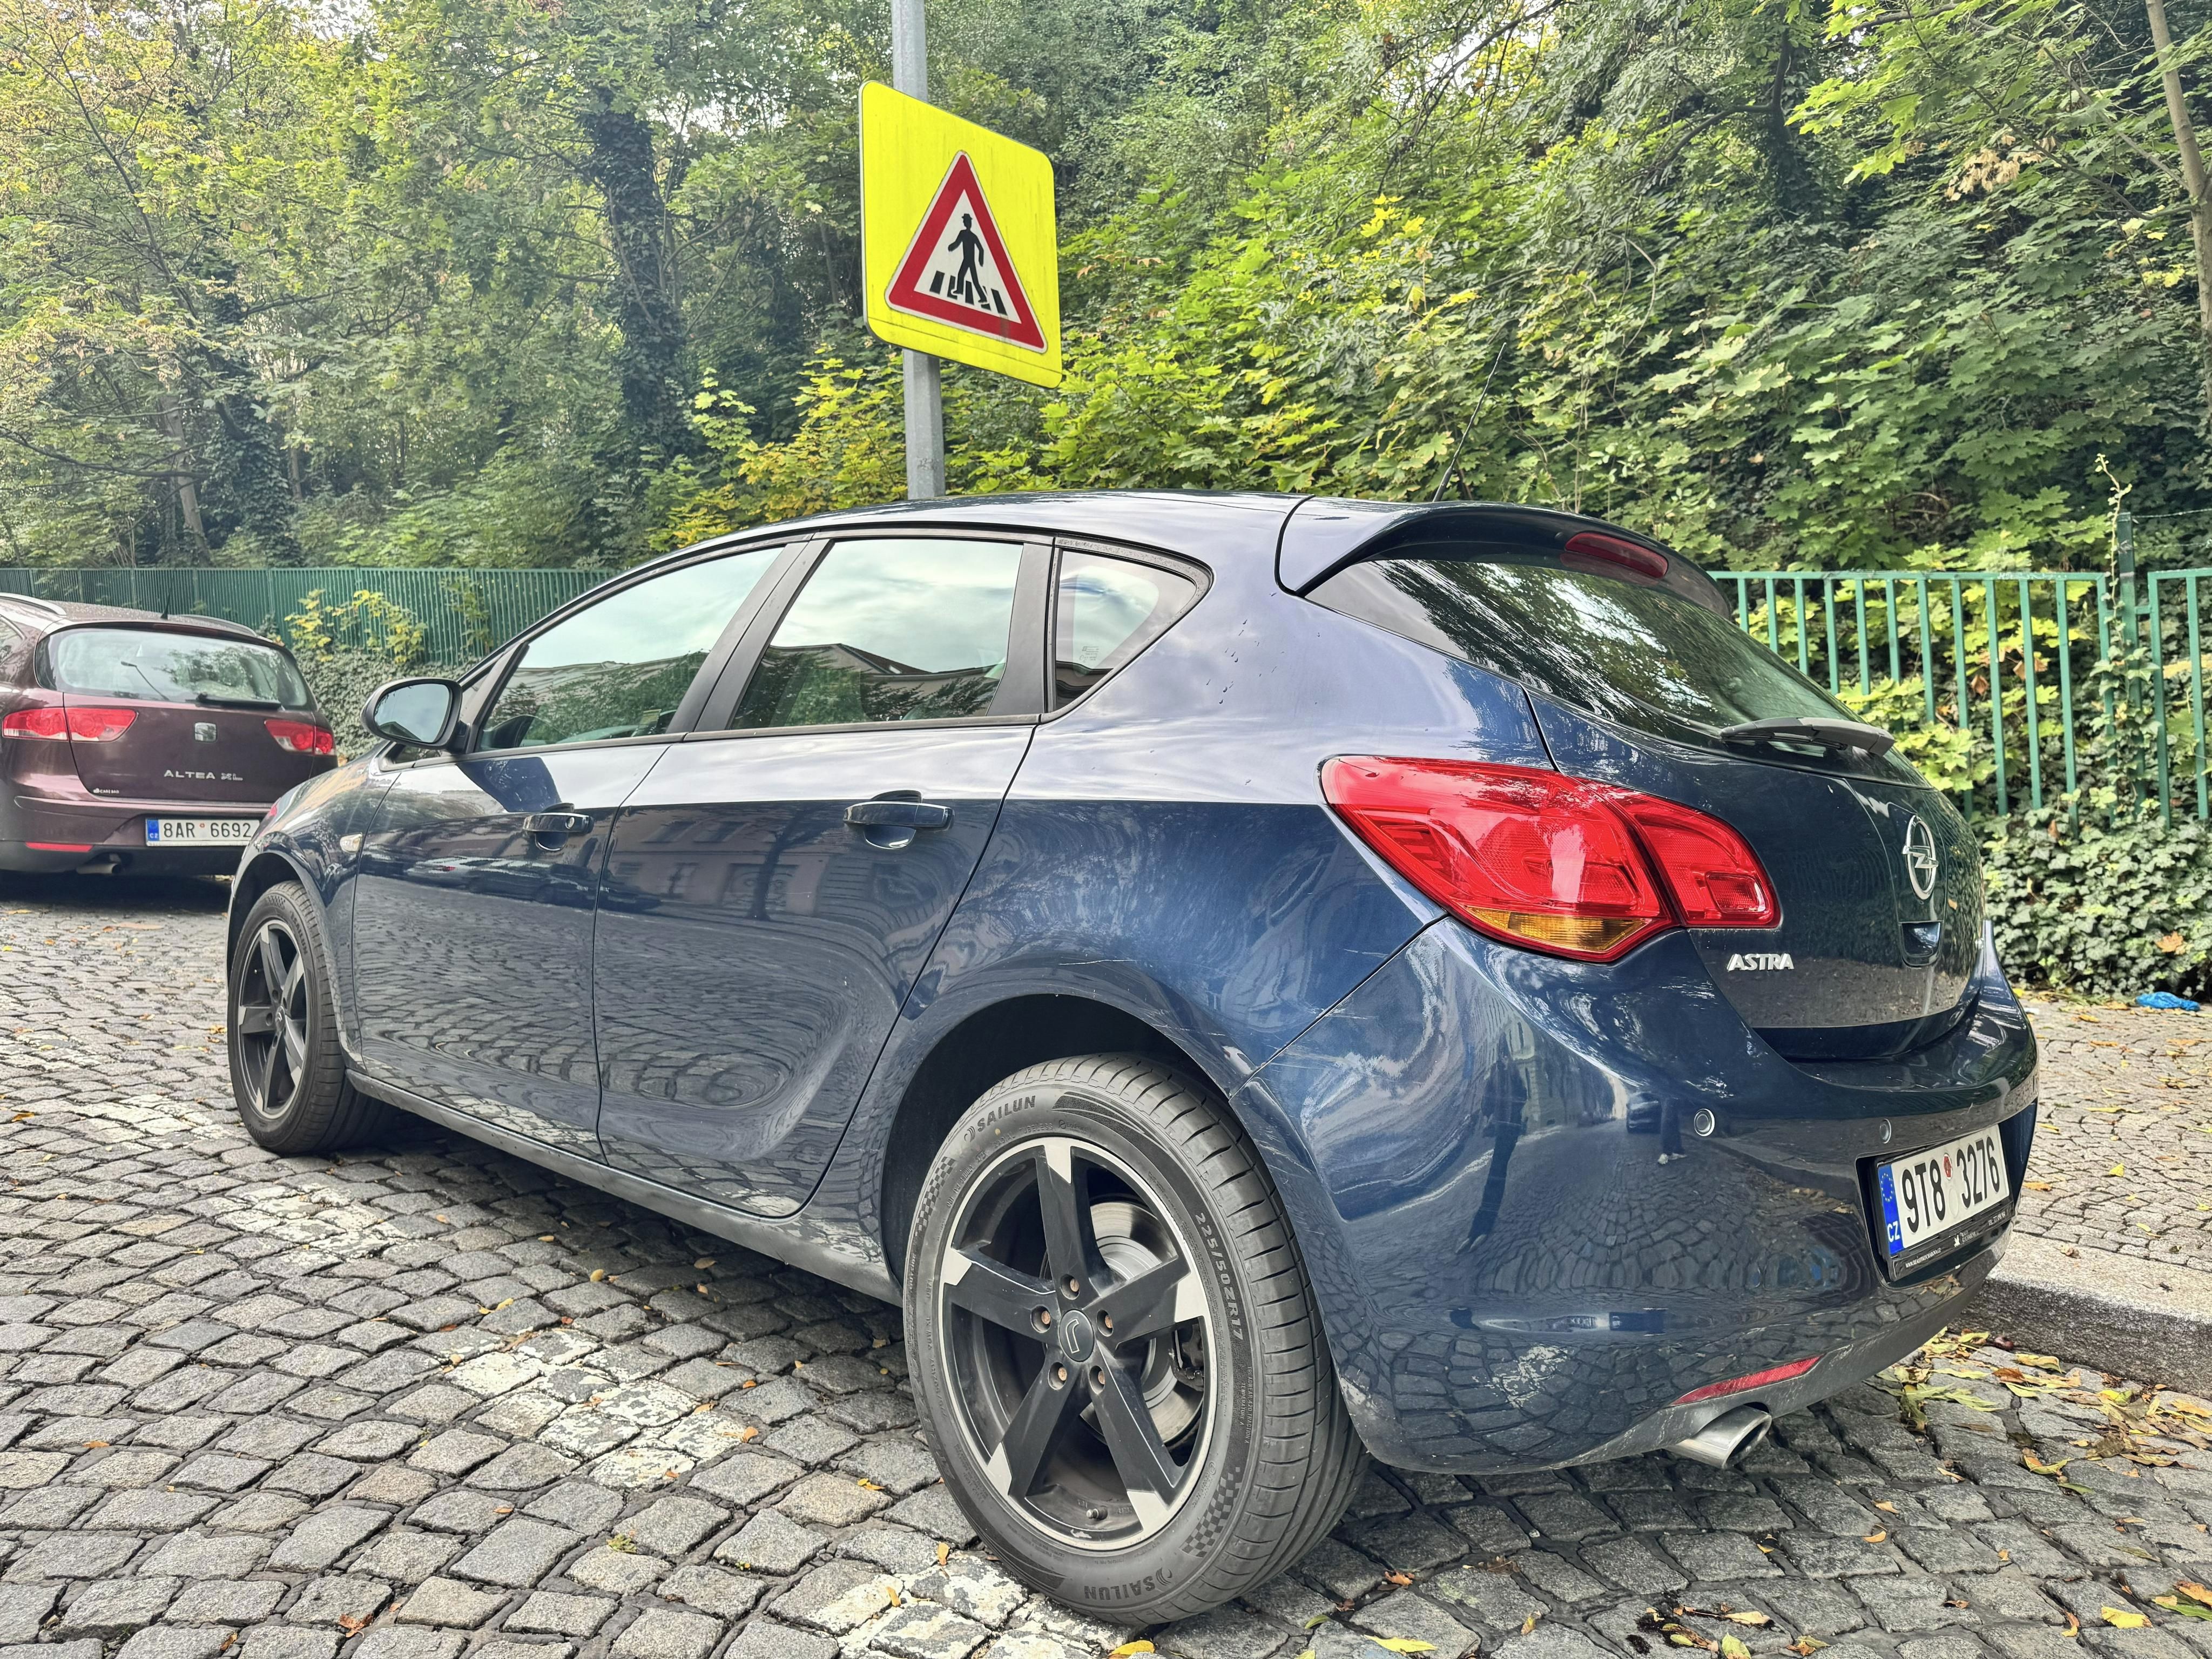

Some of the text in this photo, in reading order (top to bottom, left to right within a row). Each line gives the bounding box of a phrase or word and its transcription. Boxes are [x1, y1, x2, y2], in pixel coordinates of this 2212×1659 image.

[164, 770, 243, 781] ALTEA XL
[164, 822, 251, 838] 8AR 6692
[1727, 953, 1794, 972] ASTRA
[977, 1095, 1036, 1132] SAILUN
[1901, 1136, 1999, 1233] 9T8 3276
[1887, 1220, 1900, 1243] CZ
[1195, 1212, 1243, 1340] 225/50ZR17
[1084, 1575, 1155, 1601] SAILUN
